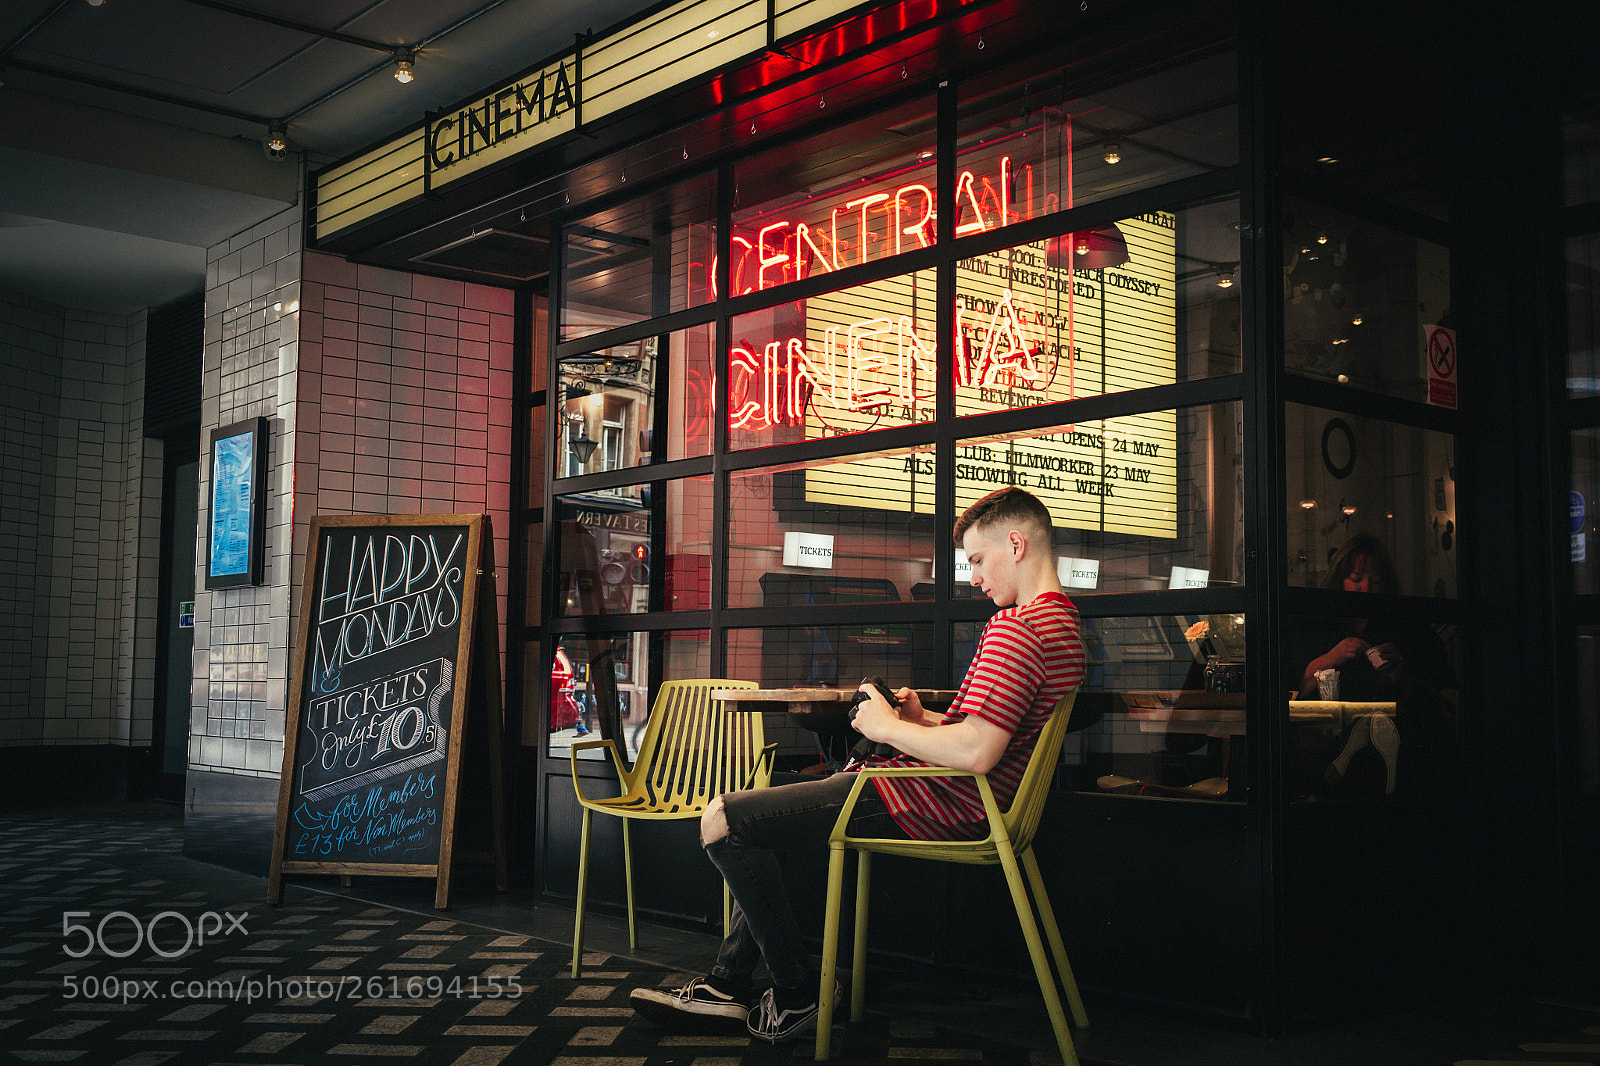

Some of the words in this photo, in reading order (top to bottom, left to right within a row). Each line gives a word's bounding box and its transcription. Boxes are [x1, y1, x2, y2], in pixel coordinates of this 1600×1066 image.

[431, 60, 575, 169] CINEMA
[1108, 272, 1161, 297] ODYSSEY
[711, 286, 1039, 429] CINEMA
[1062, 431, 1103, 449] OPENS
[1112, 438, 1127, 453] 24
[1133, 441, 1160, 457] MAY
[902, 457, 933, 476] ALS
[956, 463, 1027, 486] SHOWING
[1038, 474, 1064, 492] ALL
[1075, 479, 1114, 497] WEEK
[1005, 449, 1094, 477] FILMWORKER
[1105, 464, 1118, 479] 23
[1124, 467, 1151, 483] MAY
[799, 545, 832, 557] TICKETS
[318, 534, 463, 625] HAPPY
[1072, 569, 1097, 579] TICKETS
[312, 567, 462, 692] MONDAYS
[316, 668, 428, 730] TICKETS
[358, 772, 437, 820] Members
[294, 832, 333, 855] £13
[335, 825, 360, 852] for
